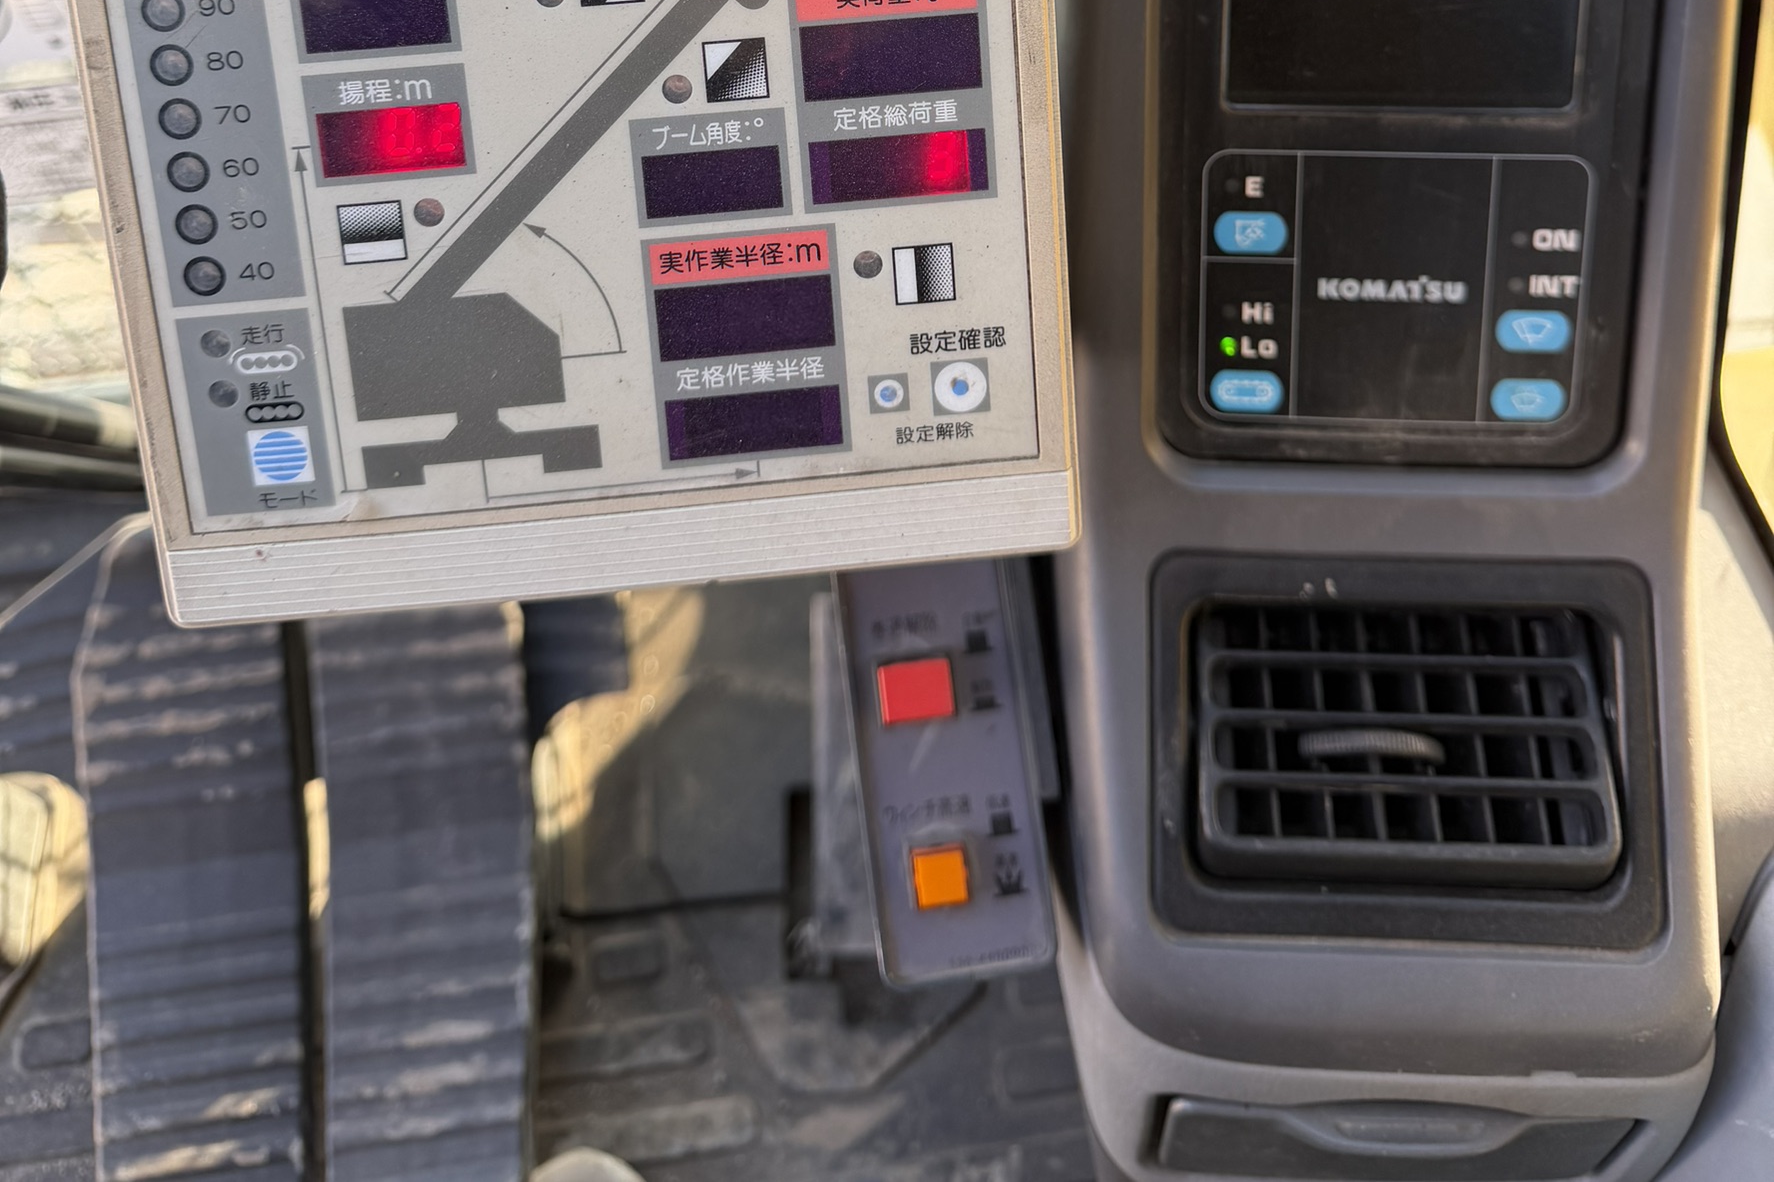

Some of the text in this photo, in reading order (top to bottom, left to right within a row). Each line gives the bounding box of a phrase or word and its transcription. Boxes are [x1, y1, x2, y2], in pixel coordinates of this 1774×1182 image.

[206, 50, 245, 72] 80
[338, 76, 433, 106] 揚程:m
[214, 103, 252, 126] 70
[832, 99, 958, 131] 定格総荷重
[222, 156, 260, 178] 60
[1244, 175, 1265, 198] E
[229, 209, 268, 230] 50
[1532, 228, 1581, 252] ON
[659, 241, 822, 275] 実作業半径:m
[239, 261, 275, 281] 40
[1317, 276, 1468, 304] KOMATSU
[1529, 274, 1580, 298] INT
[1241, 301, 1275, 325] Hi
[241, 323, 285, 346] 走行
[910, 326, 1007, 356] 設定確認
[1240, 336, 1279, 359] Lo
[676, 356, 825, 392] 定格作業半径
[249, 380, 296, 401] 静止
[895, 421, 974, 445] 設定解除
[259, 488, 318, 510] モード
